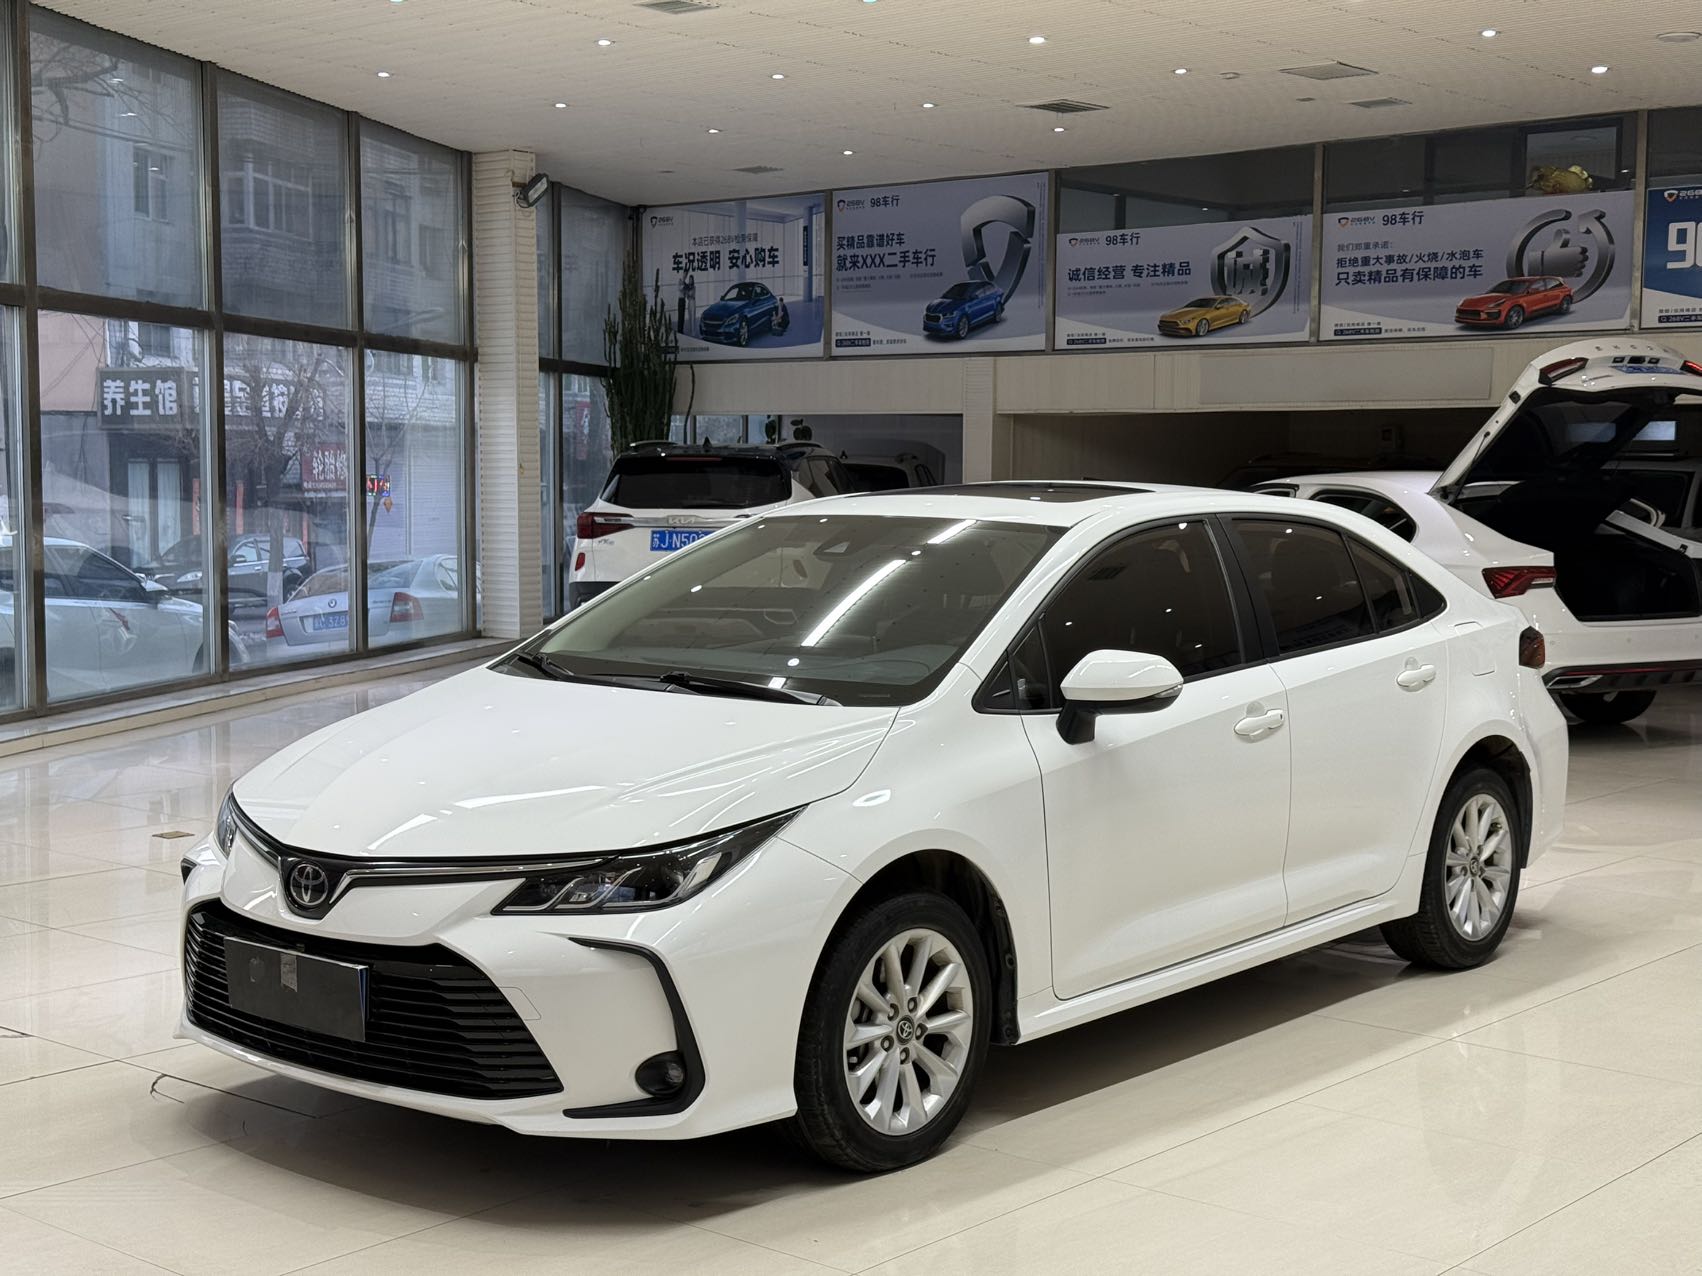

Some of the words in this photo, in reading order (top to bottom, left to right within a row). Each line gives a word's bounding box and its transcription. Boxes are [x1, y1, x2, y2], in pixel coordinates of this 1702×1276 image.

[870, 195, 900, 208] 98车行
[1382, 210, 1424, 226] 98车行
[836, 232, 905, 251] 买精品靠谱好车
[1105, 232, 1141, 246] 98车行
[1666, 221, 1702, 270] 9
[672, 250, 721, 273] 车况透明
[728, 246, 780, 270] 安心购车
[836, 248, 936, 272] 就来XXX二手车行
[1336, 248, 1484, 269] 拒绝重大事故/火烧/水泡车
[1067, 264, 1127, 283] 诚信经营
[1131, 261, 1192, 279] 专注精品
[1335, 264, 1484, 287] 只卖精品有保障的车
[103, 378, 178, 416] 养生馆
